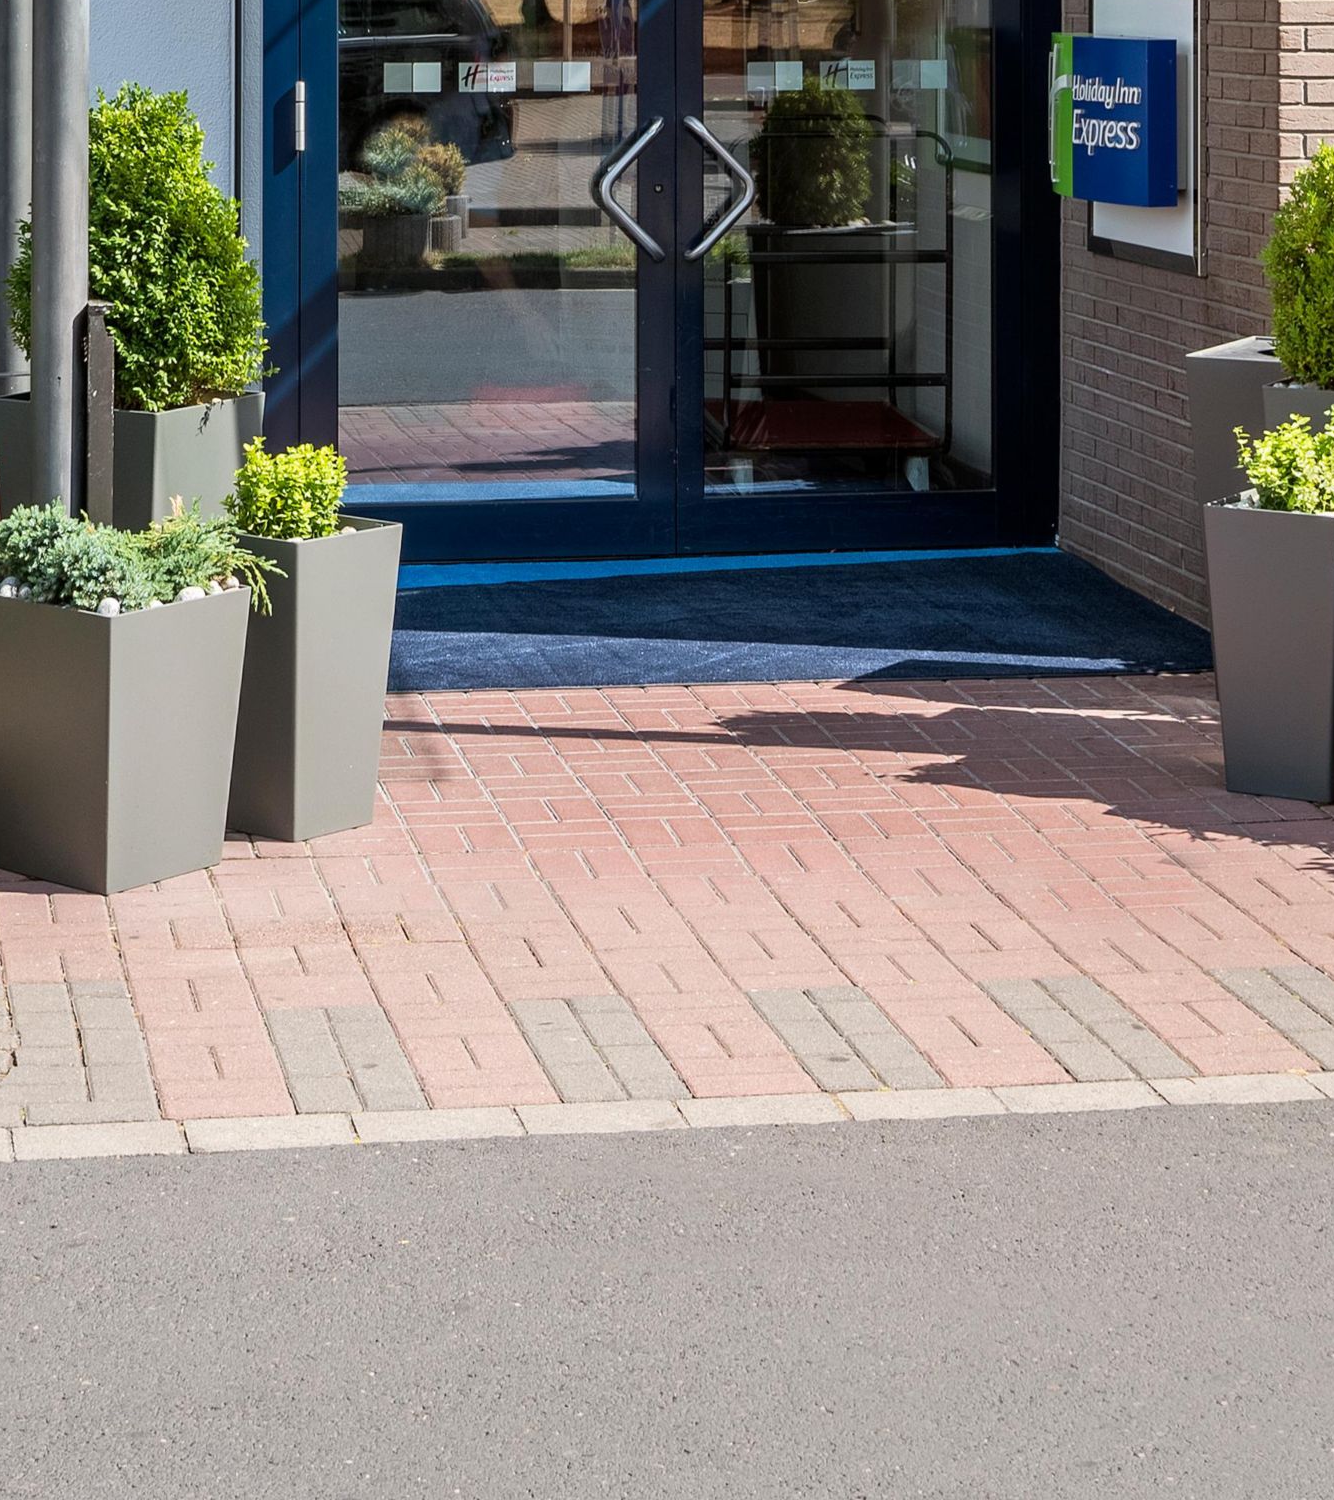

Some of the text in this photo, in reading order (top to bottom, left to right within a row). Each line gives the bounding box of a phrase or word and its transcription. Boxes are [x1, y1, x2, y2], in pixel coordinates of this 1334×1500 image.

[1072, 74, 1142, 109] Holiday Inn
[1072, 109, 1141, 156] Express
